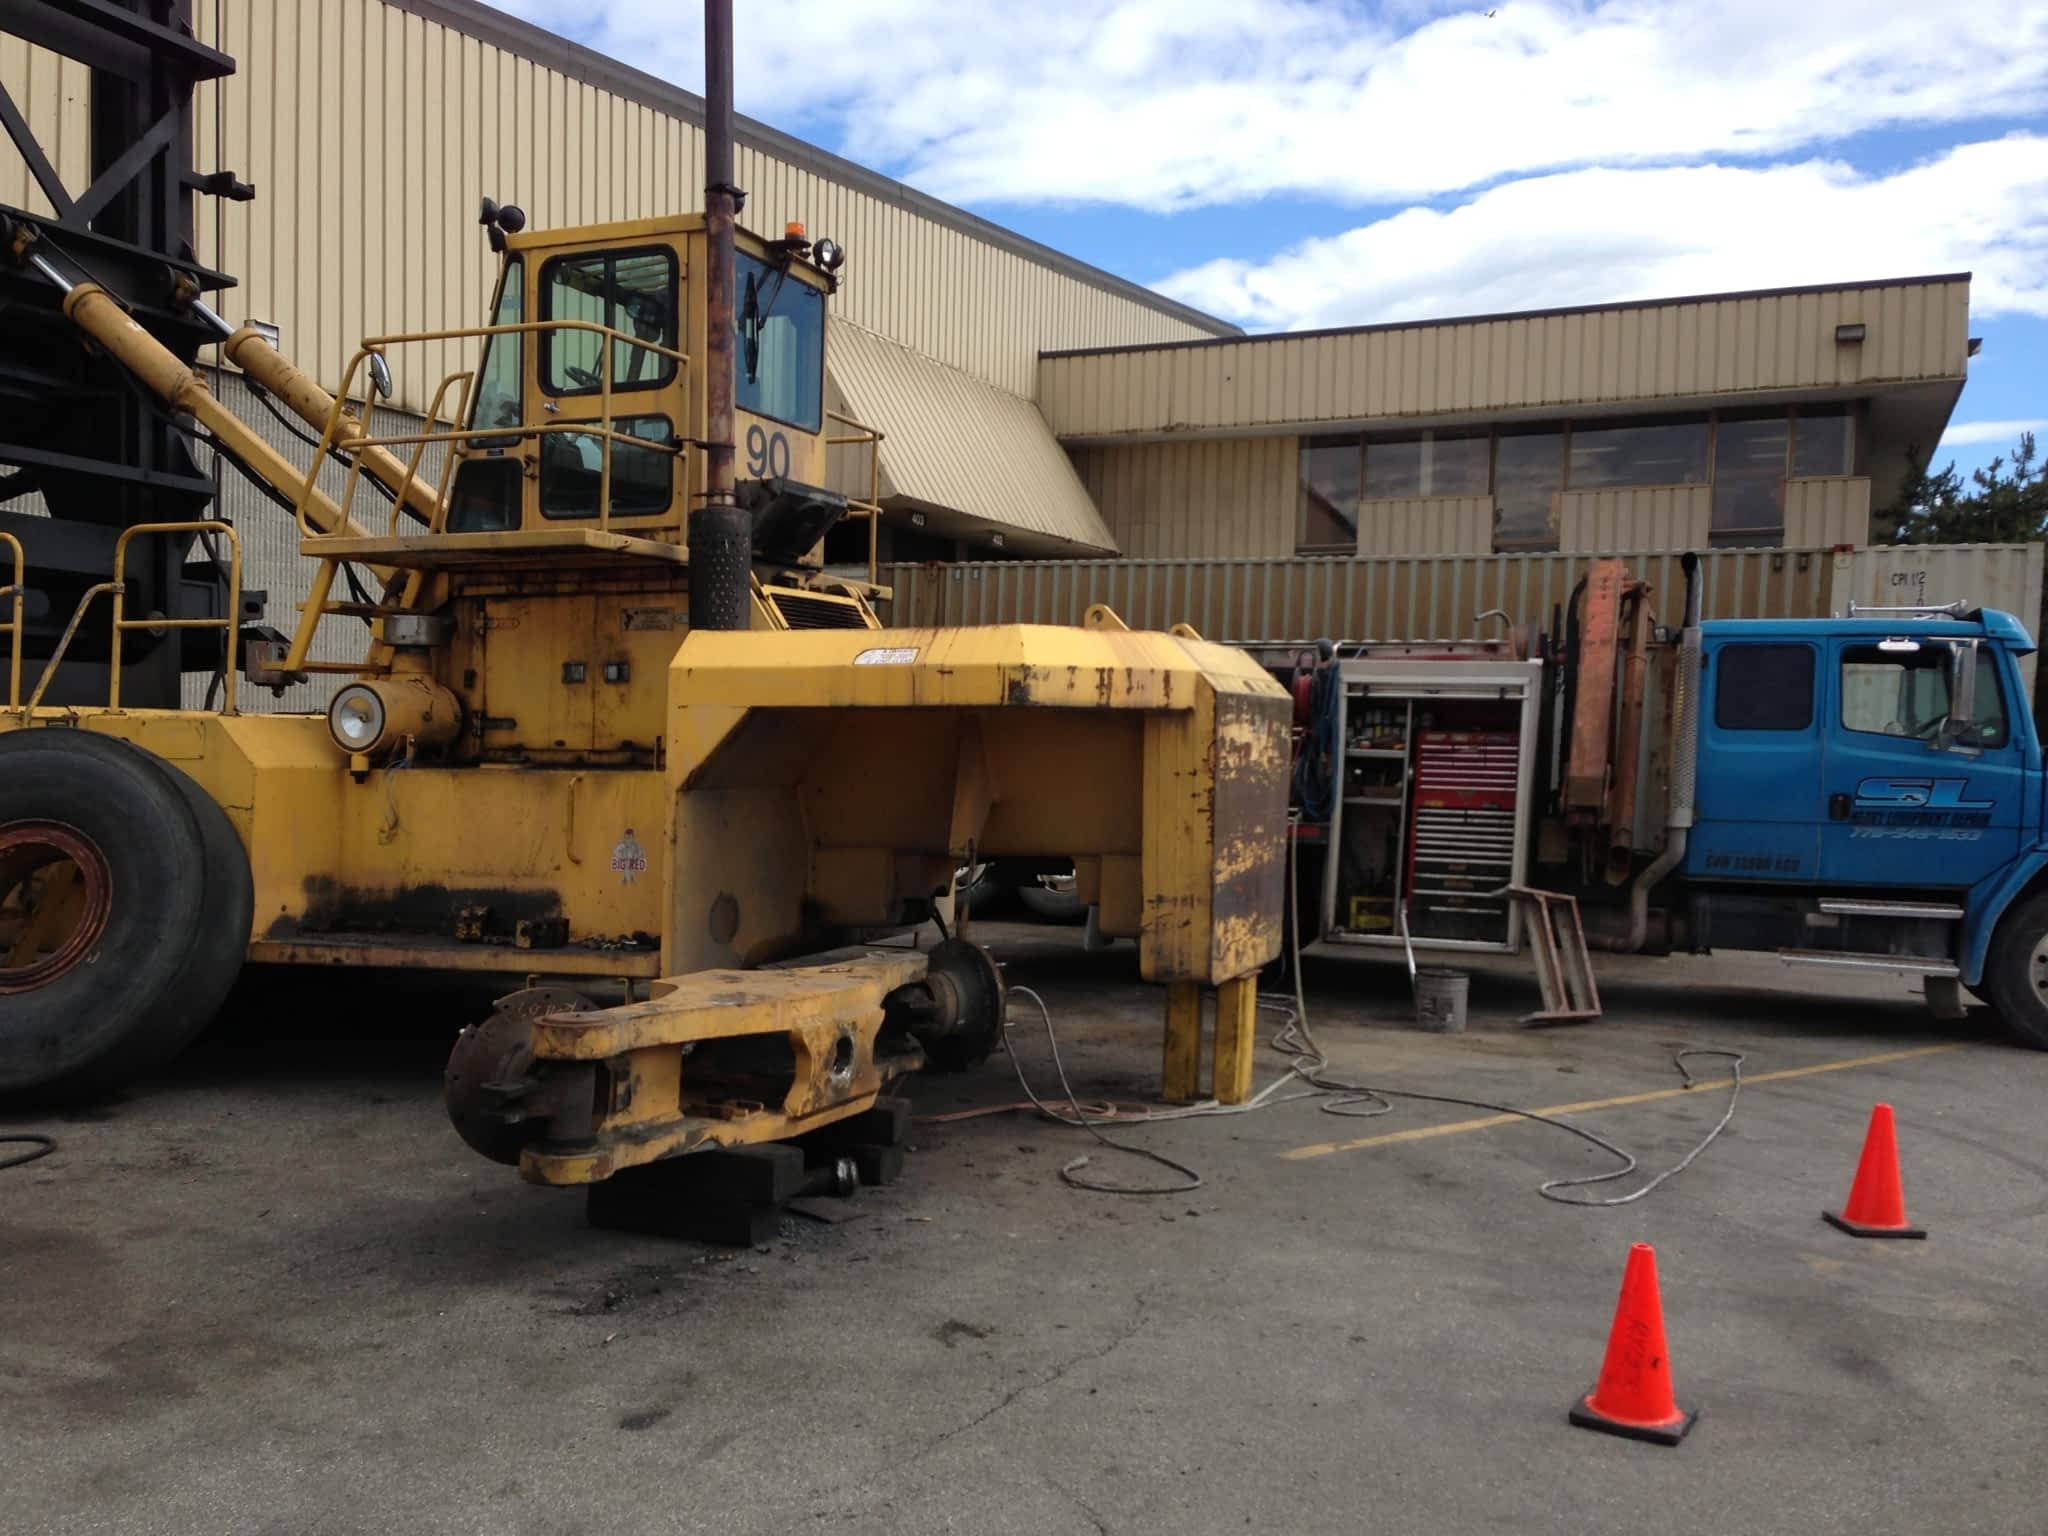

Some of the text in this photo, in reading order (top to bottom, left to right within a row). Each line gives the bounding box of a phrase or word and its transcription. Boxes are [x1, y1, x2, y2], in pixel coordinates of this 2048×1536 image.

[747, 424, 790, 480] 90
[1855, 777, 1995, 808] SL
[611, 858, 646, 870] BIG RED
